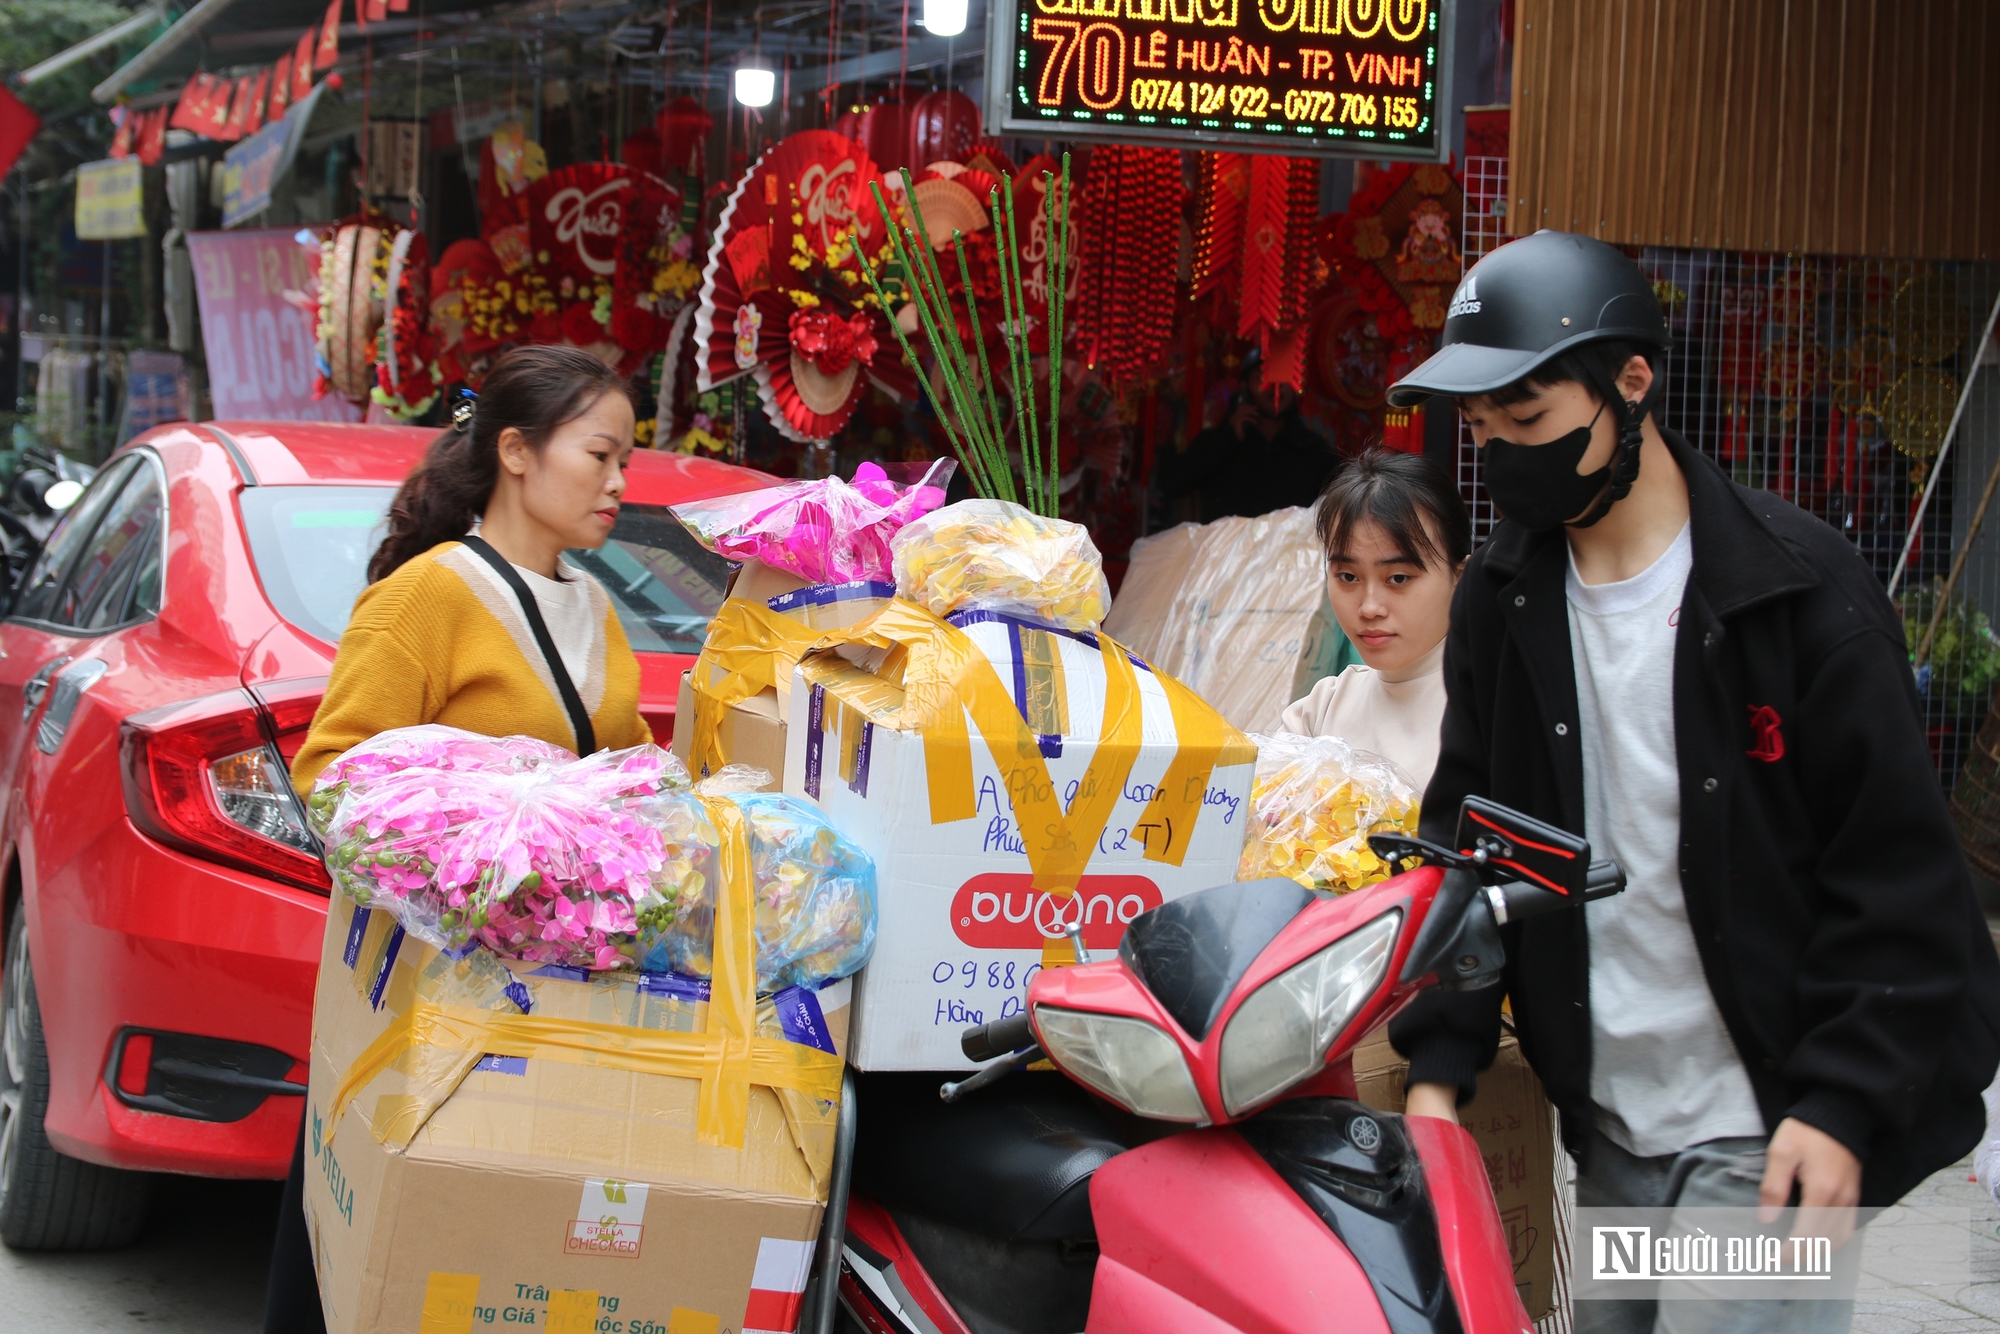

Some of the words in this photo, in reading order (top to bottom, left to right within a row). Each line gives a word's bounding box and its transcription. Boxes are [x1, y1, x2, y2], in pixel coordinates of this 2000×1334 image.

[1033, 18, 1125, 109] 70
[1134, 29, 1168, 68] LÊ
[1298, 48, 1335, 81] TP.
[1346, 52, 1421, 87] VINH
[1130, 78, 1185, 112] 0974
[1189, 81, 1226, 114] 124
[1340, 92, 1378, 126] 706
[1383, 94, 1418, 128] 155
[977, 775, 1001, 815] A
[322, 1143, 354, 1228] STELLA
[568, 1237, 638, 1253] CHECKED
[586, 1226, 624, 1237] STELLA
[502, 1306, 535, 1325] Giá
